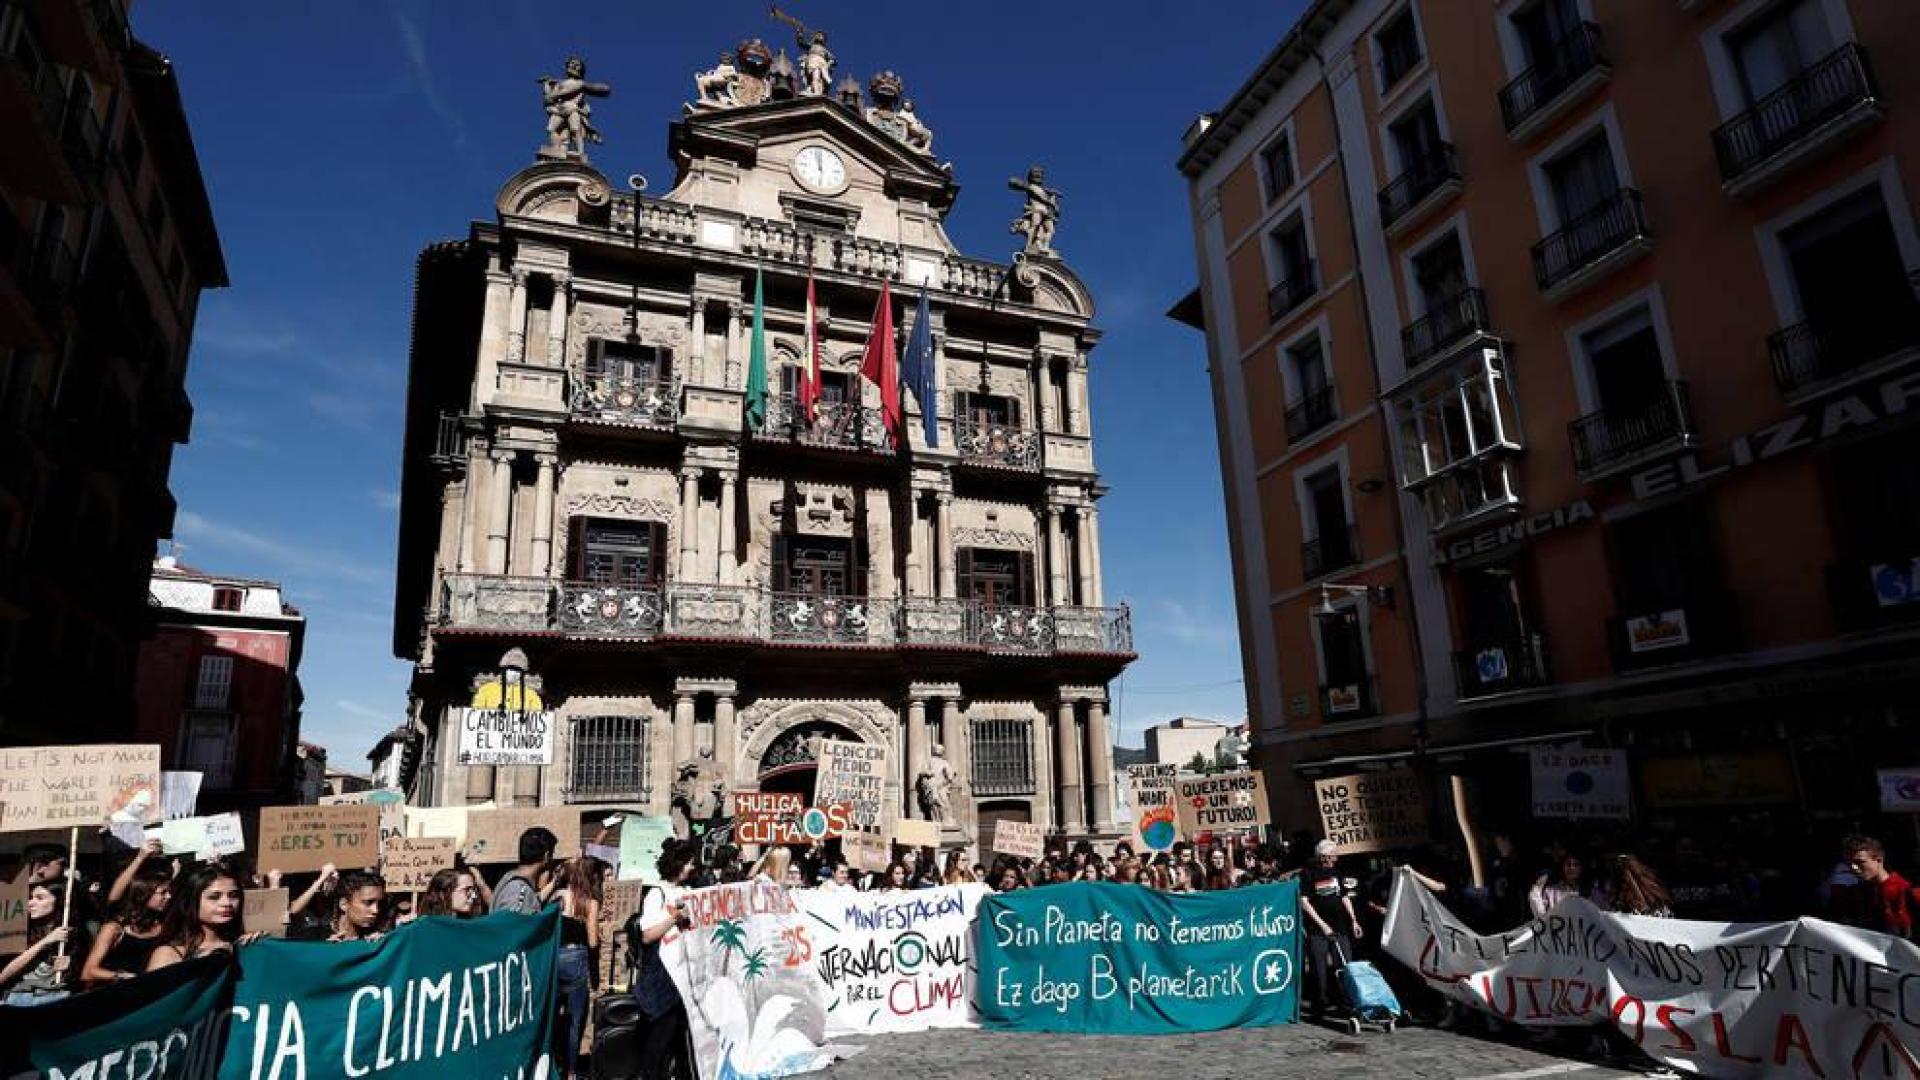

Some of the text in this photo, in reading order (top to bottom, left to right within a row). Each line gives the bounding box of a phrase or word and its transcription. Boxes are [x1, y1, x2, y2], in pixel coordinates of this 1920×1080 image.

[1430, 499, 1597, 567] AGENCIA
[467, 709, 547, 734] CAMBIEMOS
[477, 733, 544, 749] EL MUNDO
[73, 753, 104, 765] NOT
[1182, 776, 1258, 798] QUEREMOS
[1321, 784, 1349, 800] NO
[737, 795, 803, 814] HUELGA
[1209, 795, 1229, 808] UN
[1322, 799, 1351, 815] QUE
[739, 819, 802, 842] CLIMA
[993, 910, 1039, 948] Sin
[1044, 905, 1124, 945] Planeta
[1135, 919, 1161, 942] no
[1168, 914, 1244, 946] tenemos
[997, 966, 1022, 1008] Ez
[1030, 964, 1081, 1014] dago
[1091, 952, 1118, 1001] B
[343, 951, 534, 1077] CLIMATICA
